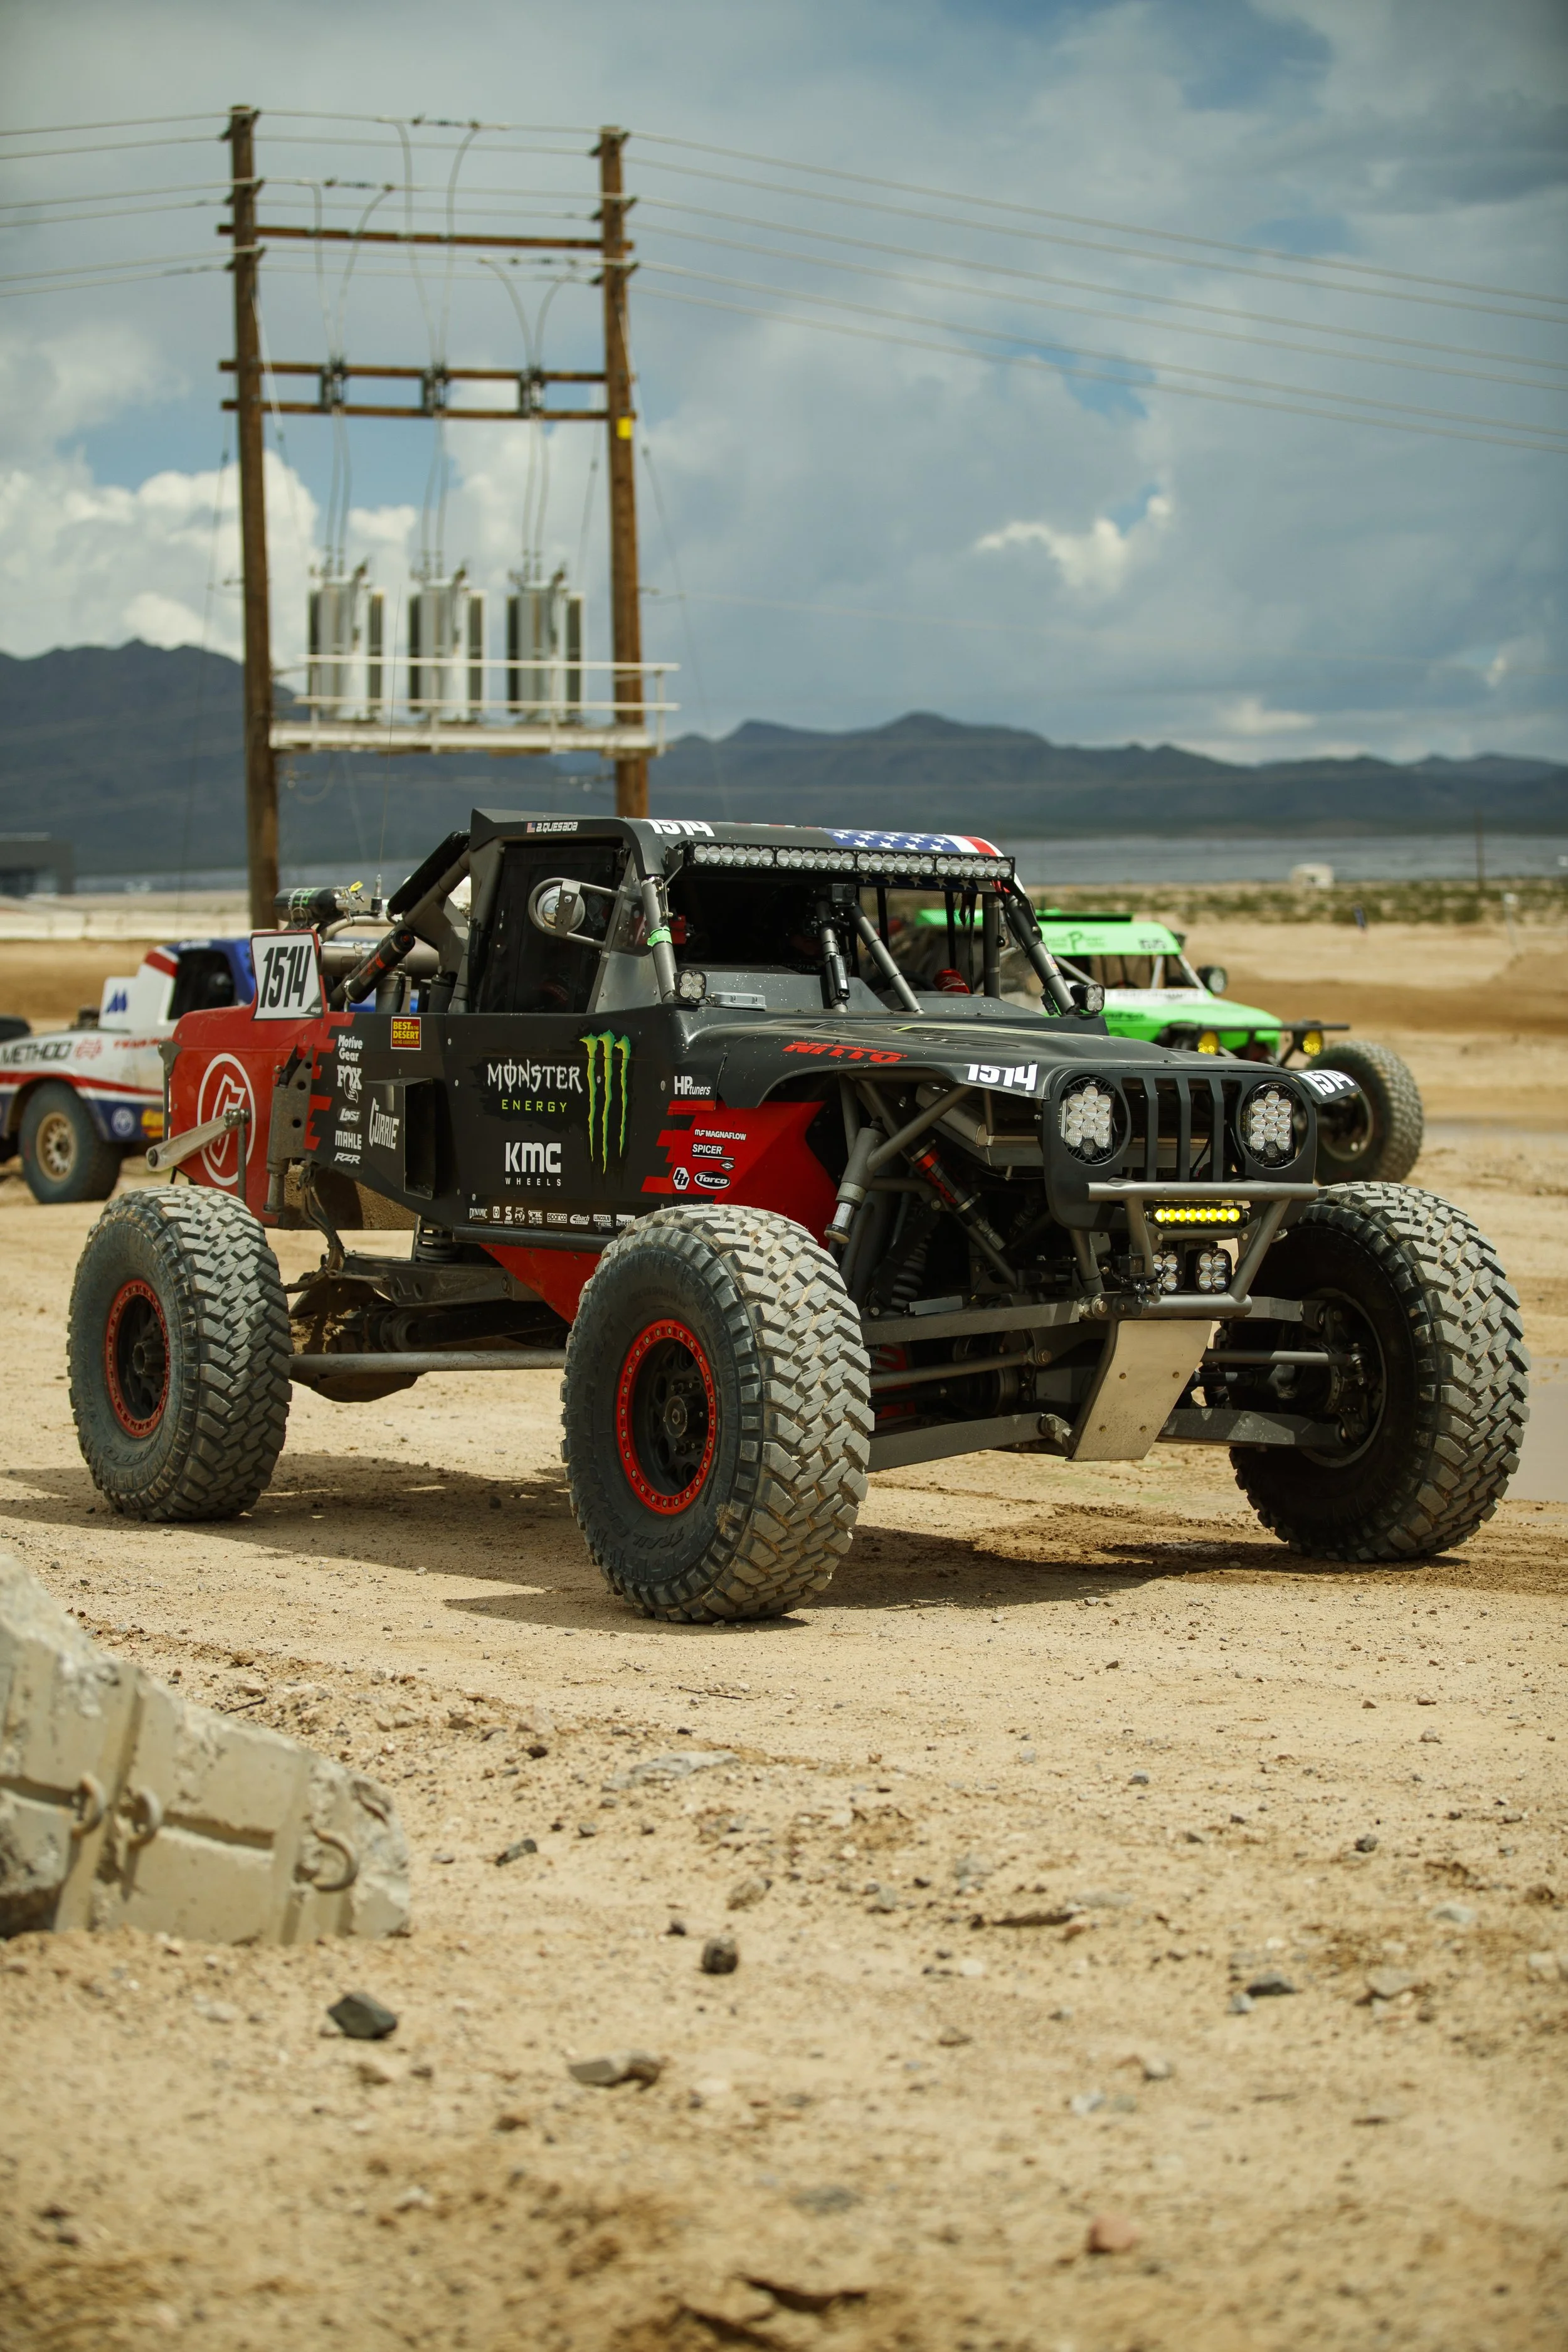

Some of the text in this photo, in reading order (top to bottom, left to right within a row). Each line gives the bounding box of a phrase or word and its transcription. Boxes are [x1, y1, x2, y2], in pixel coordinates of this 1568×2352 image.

[640, 819, 715, 837] 1514
[260, 945, 312, 1009] 1514
[393, 1021, 411, 1030] BEST
[337, 1034, 363, 1050] Motive
[393, 1030, 420, 1039] DESERT
[339, 1047, 359, 1062] Gear
[783, 1041, 904, 1063] NITTO
[337, 1064, 362, 1104] FOX
[487, 1059, 583, 1094] MONSTER
[963, 1064, 1038, 1091] 1514
[1297, 1070, 1355, 1096] 1514
[502, 1099, 567, 1113] ENERGY
[334, 1130, 362, 1150] MAHLE
[705, 1130, 746, 1140] MAGNAFLOW
[692, 1143, 723, 1155] SPICER
[334, 1152, 361, 1164] RZR
[505, 1142, 561, 1173] KMC
[505, 1177, 561, 1187] WHEELS
[699, 1174, 728, 1185] Torco
[469, 1208, 488, 1219] DYNAMIC
